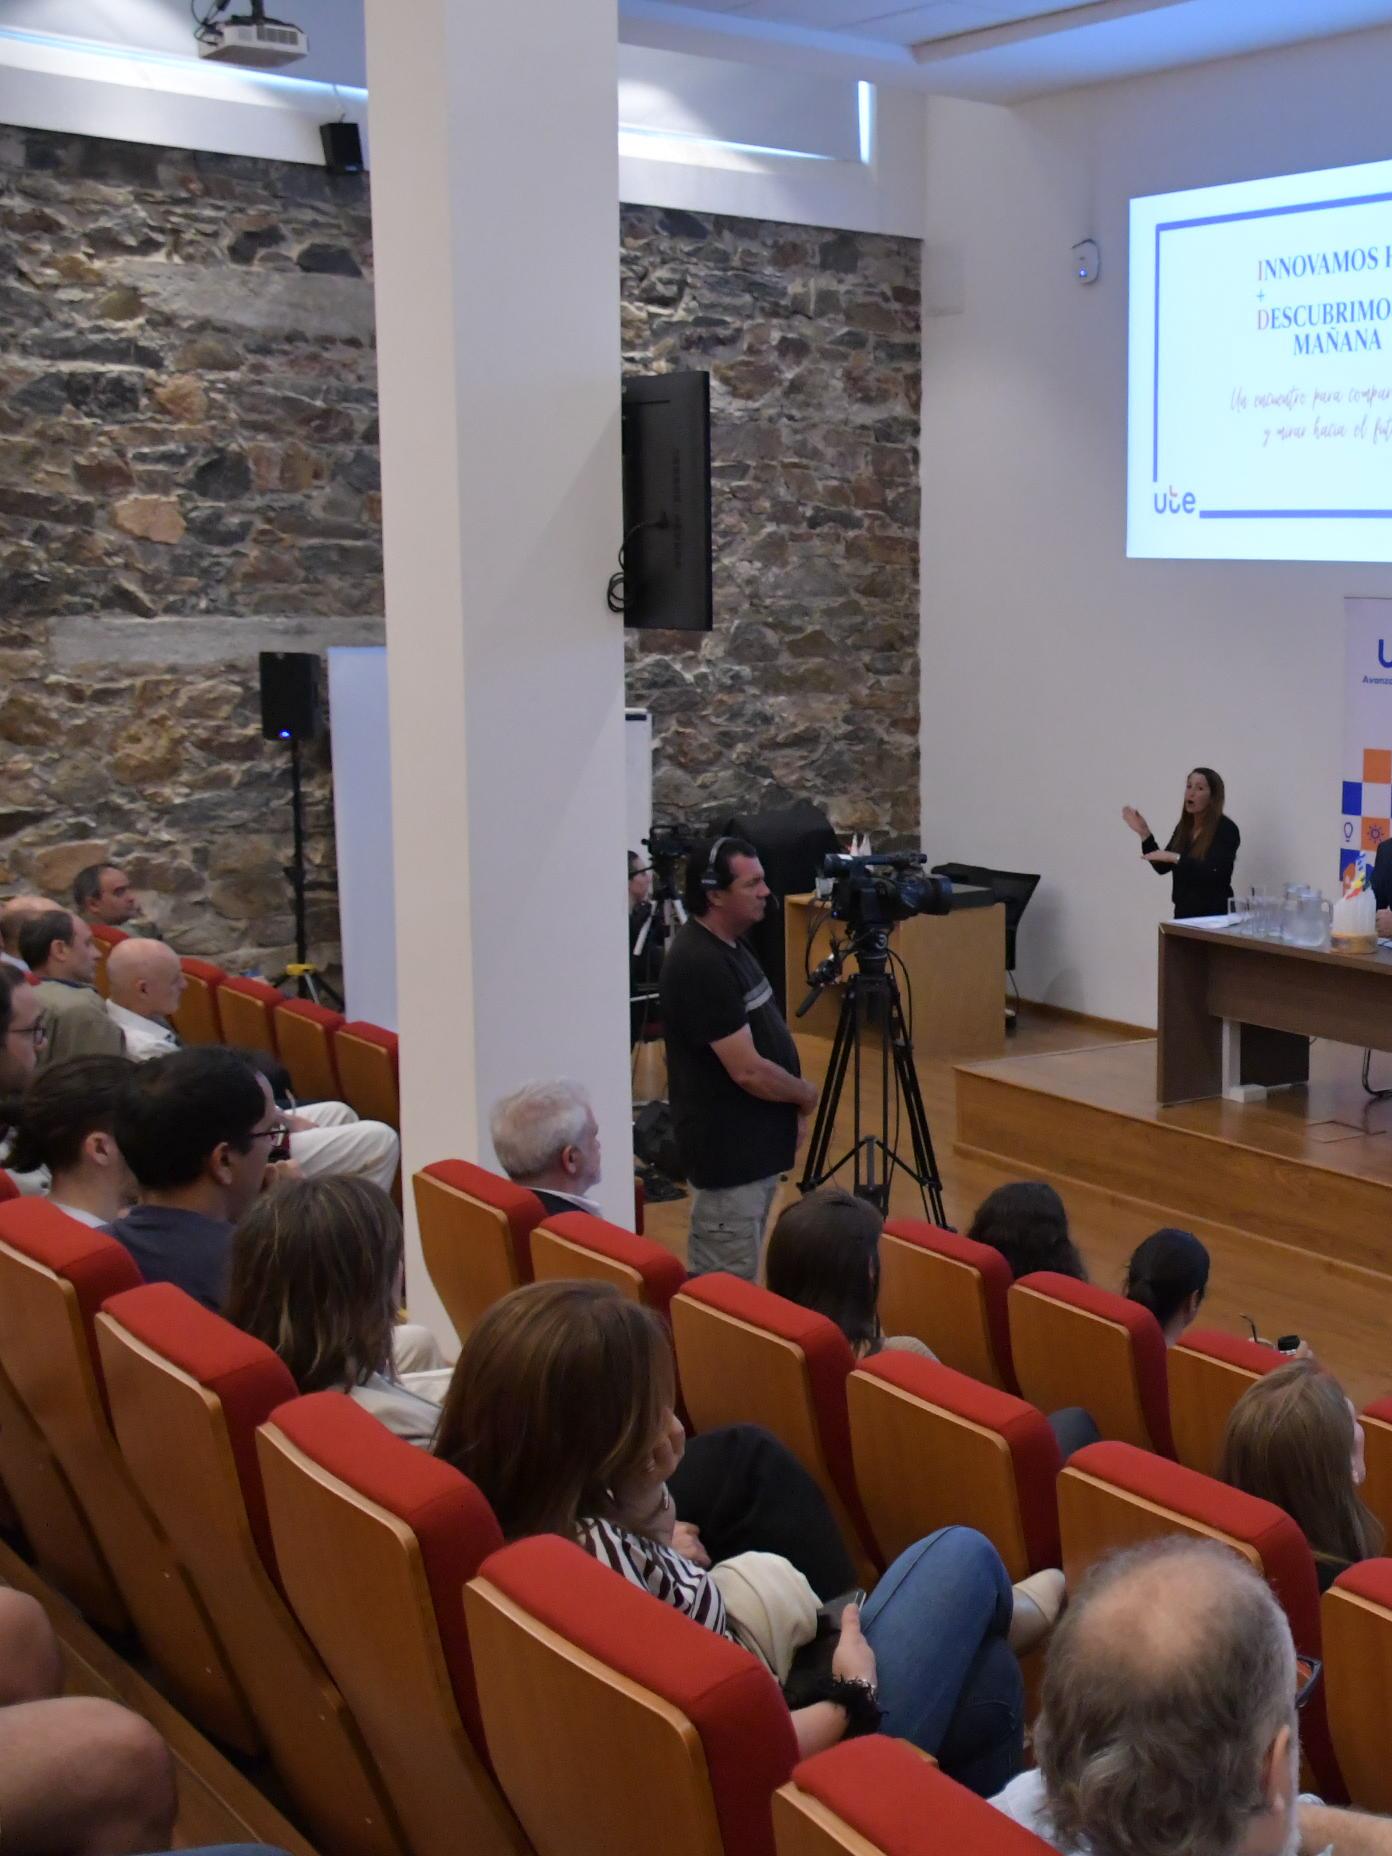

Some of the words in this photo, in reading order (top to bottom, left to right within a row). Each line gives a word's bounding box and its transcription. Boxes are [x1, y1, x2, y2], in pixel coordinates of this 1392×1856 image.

[1257, 246, 1379, 281] INNOVAMOS
[1293, 326, 1383, 356] MAÑANA
[1154, 484, 1196, 514] ute
